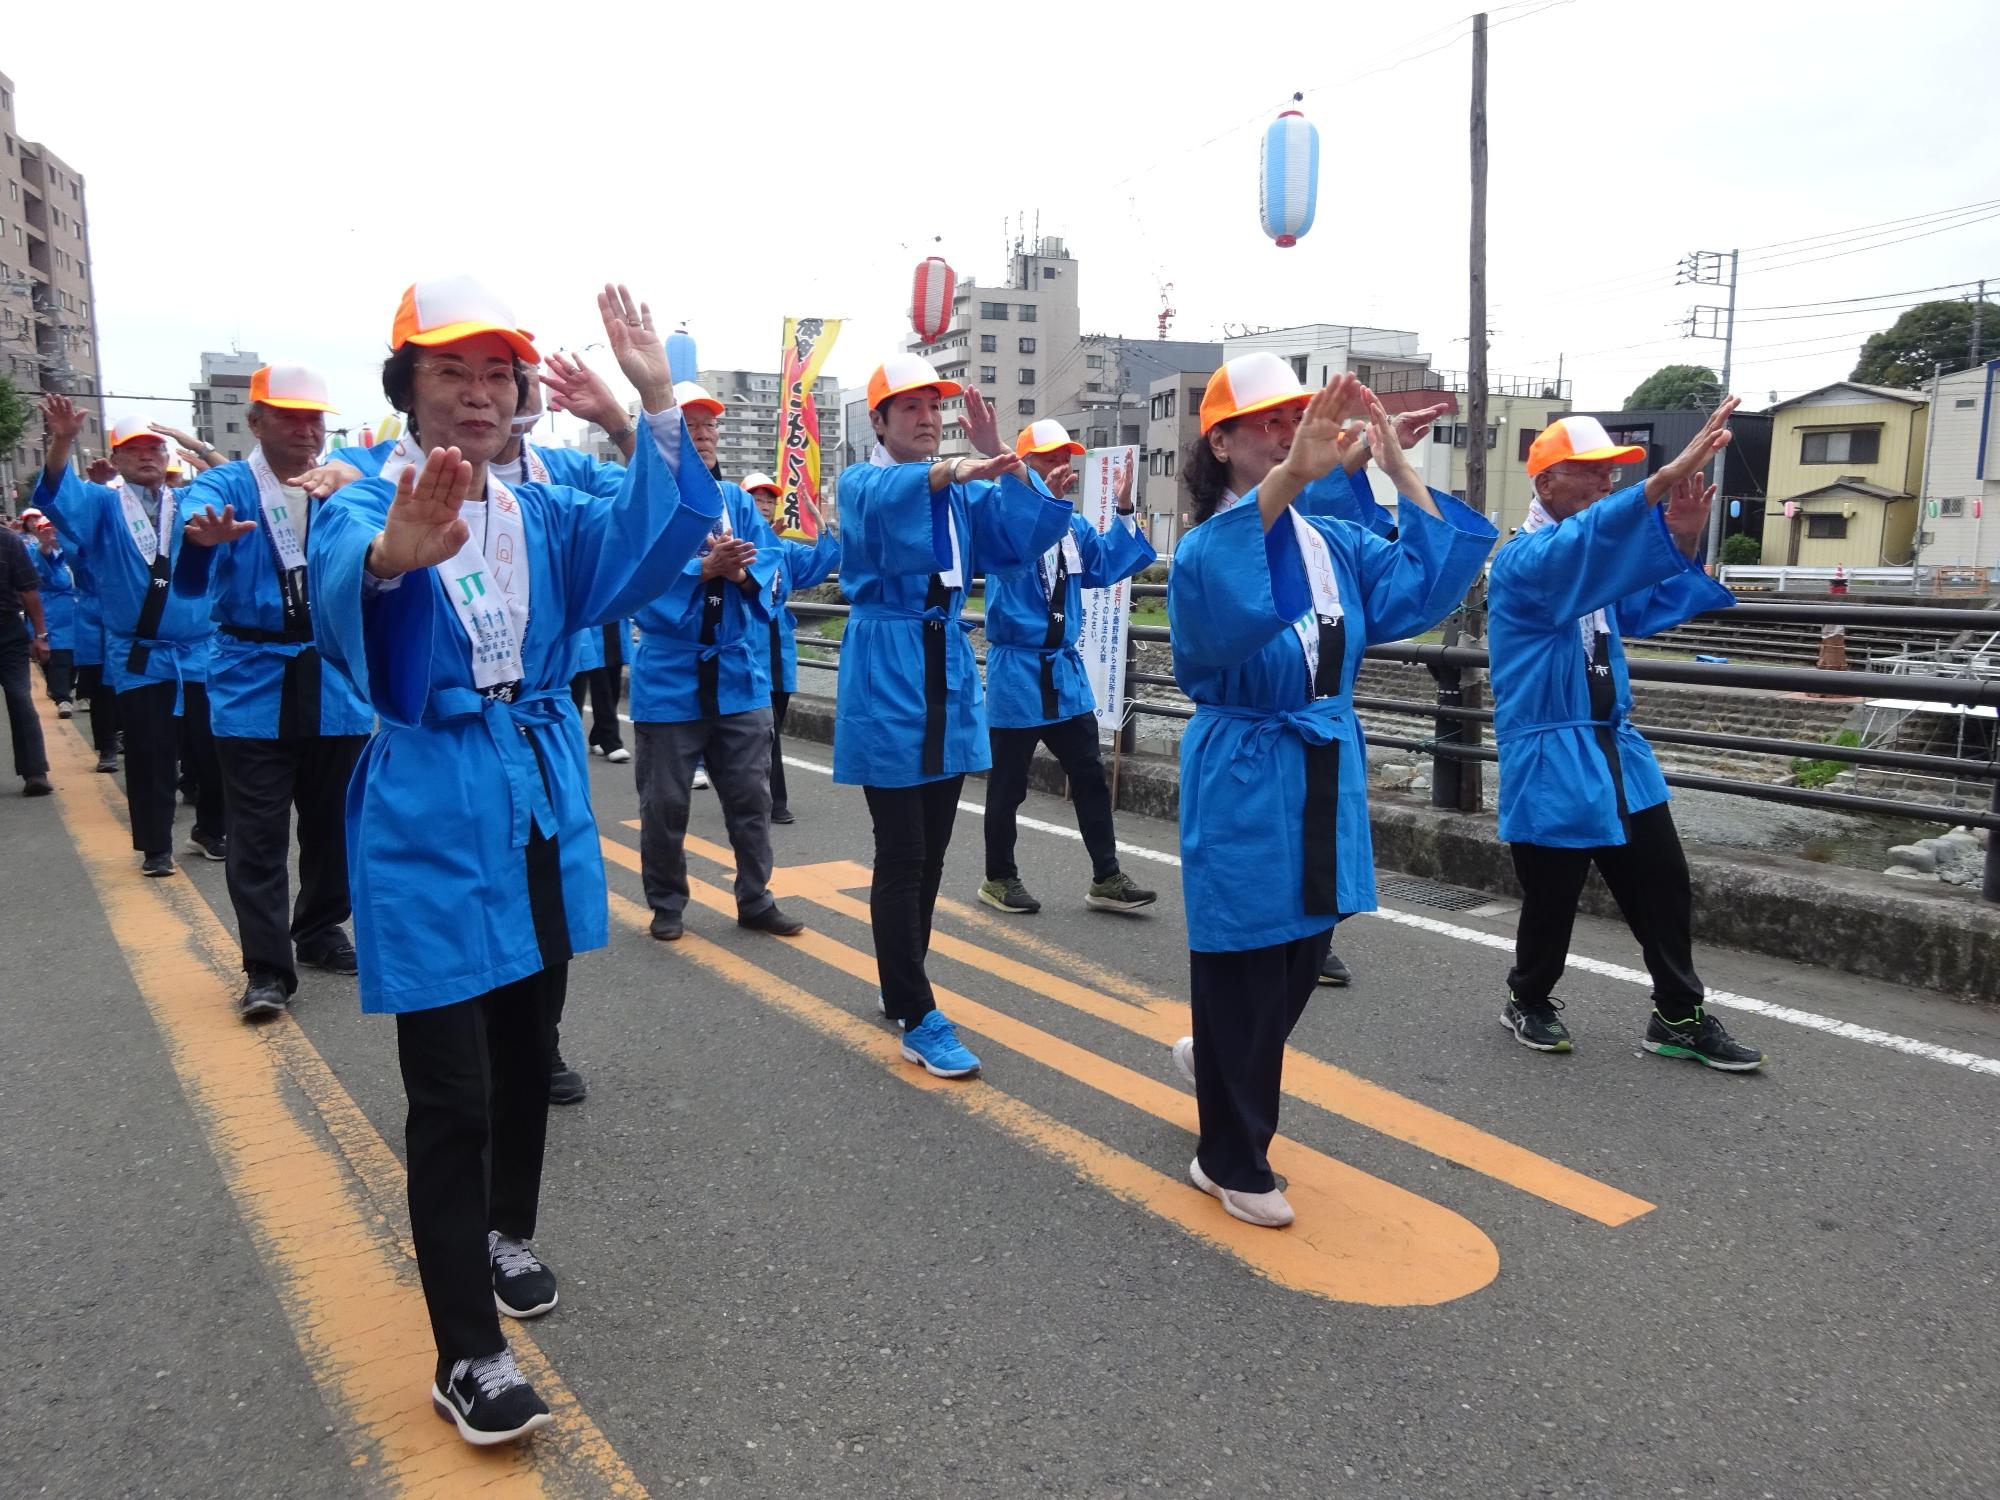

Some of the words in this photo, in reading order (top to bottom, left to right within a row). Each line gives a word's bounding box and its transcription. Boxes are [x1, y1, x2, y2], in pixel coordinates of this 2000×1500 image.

[271, 505, 288, 525] JT
[456, 570, 486, 606] JT
[1091, 588, 1100, 643] 承ください。
